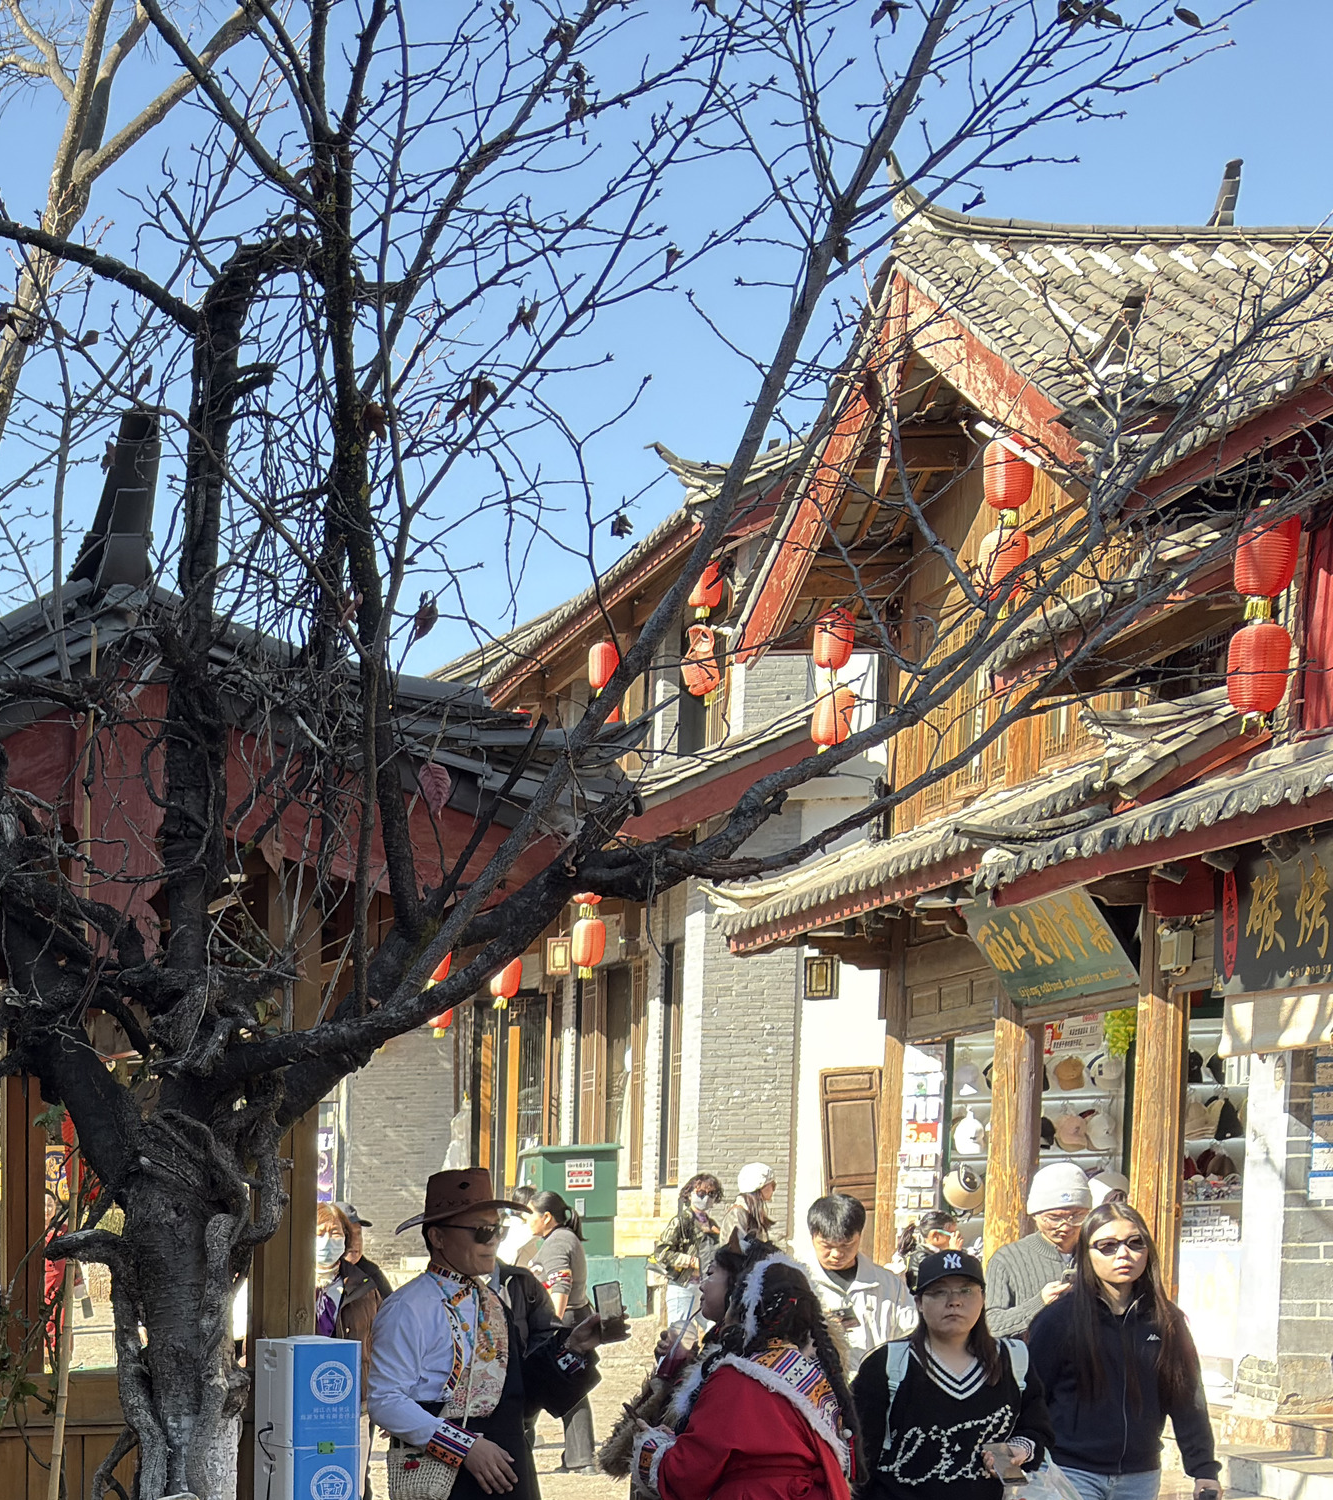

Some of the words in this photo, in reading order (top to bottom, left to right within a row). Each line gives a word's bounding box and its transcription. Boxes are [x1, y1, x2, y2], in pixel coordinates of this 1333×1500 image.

[977, 891, 1114, 973] 丽江文创市集
[943, 1253, 962, 1269] NY
